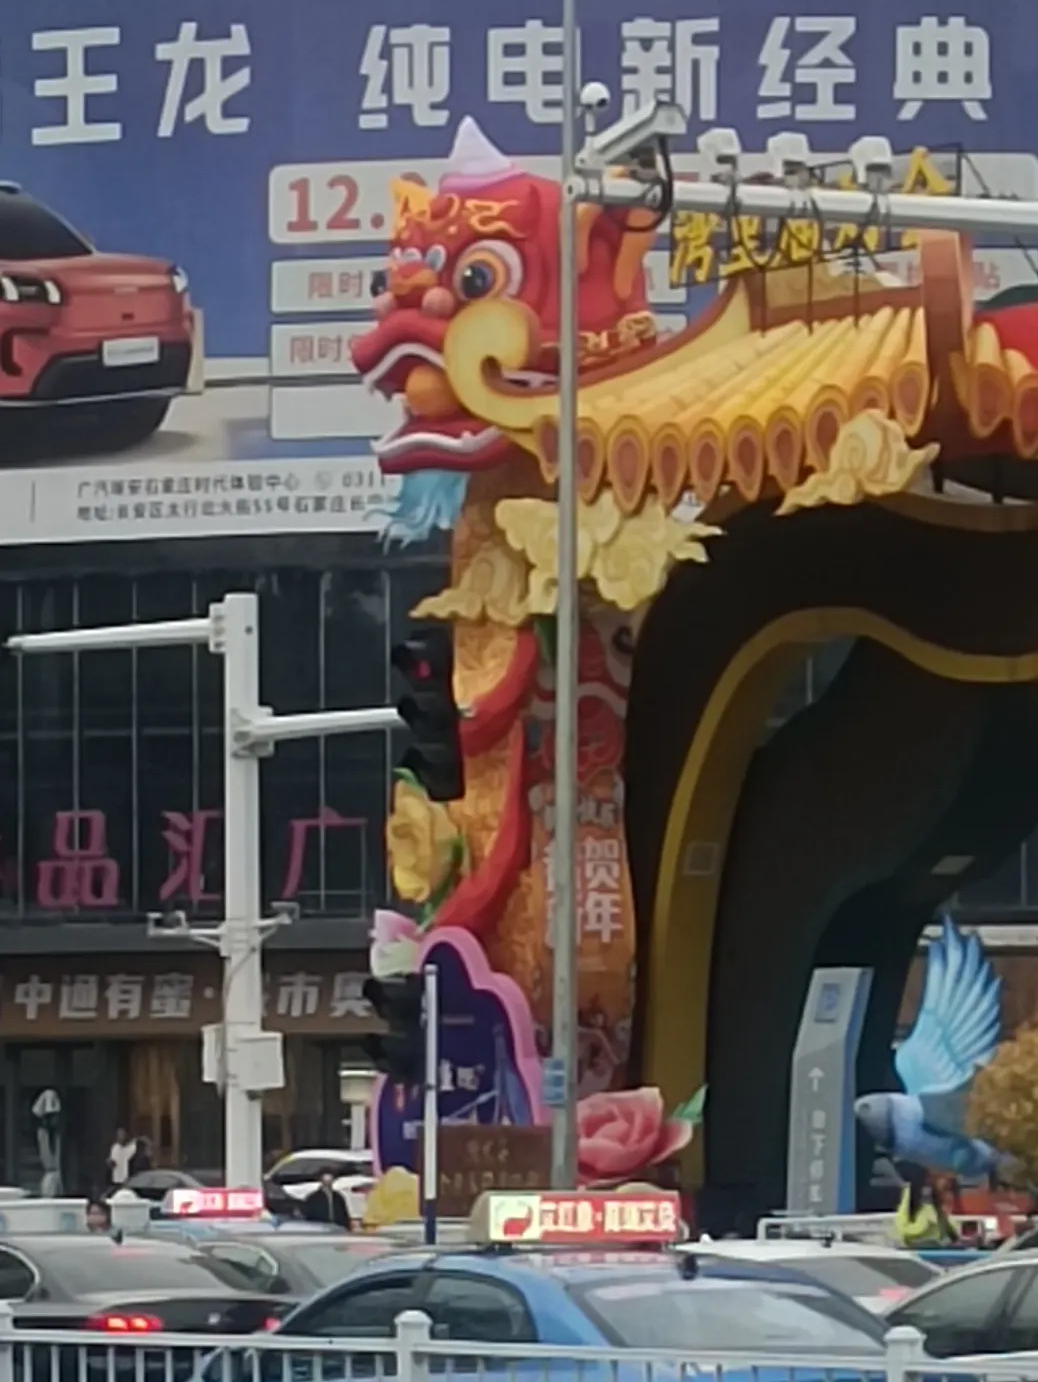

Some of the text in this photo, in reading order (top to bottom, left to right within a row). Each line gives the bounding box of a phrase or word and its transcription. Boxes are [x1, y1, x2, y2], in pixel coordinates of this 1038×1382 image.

[32, 16, 993, 145] 王龙 纯电新经典
[290, 333, 360, 364] 限时
[0, 805, 367, 909] 品汇广
[15, 972, 377, 1020] 中通有蜜·市奥
